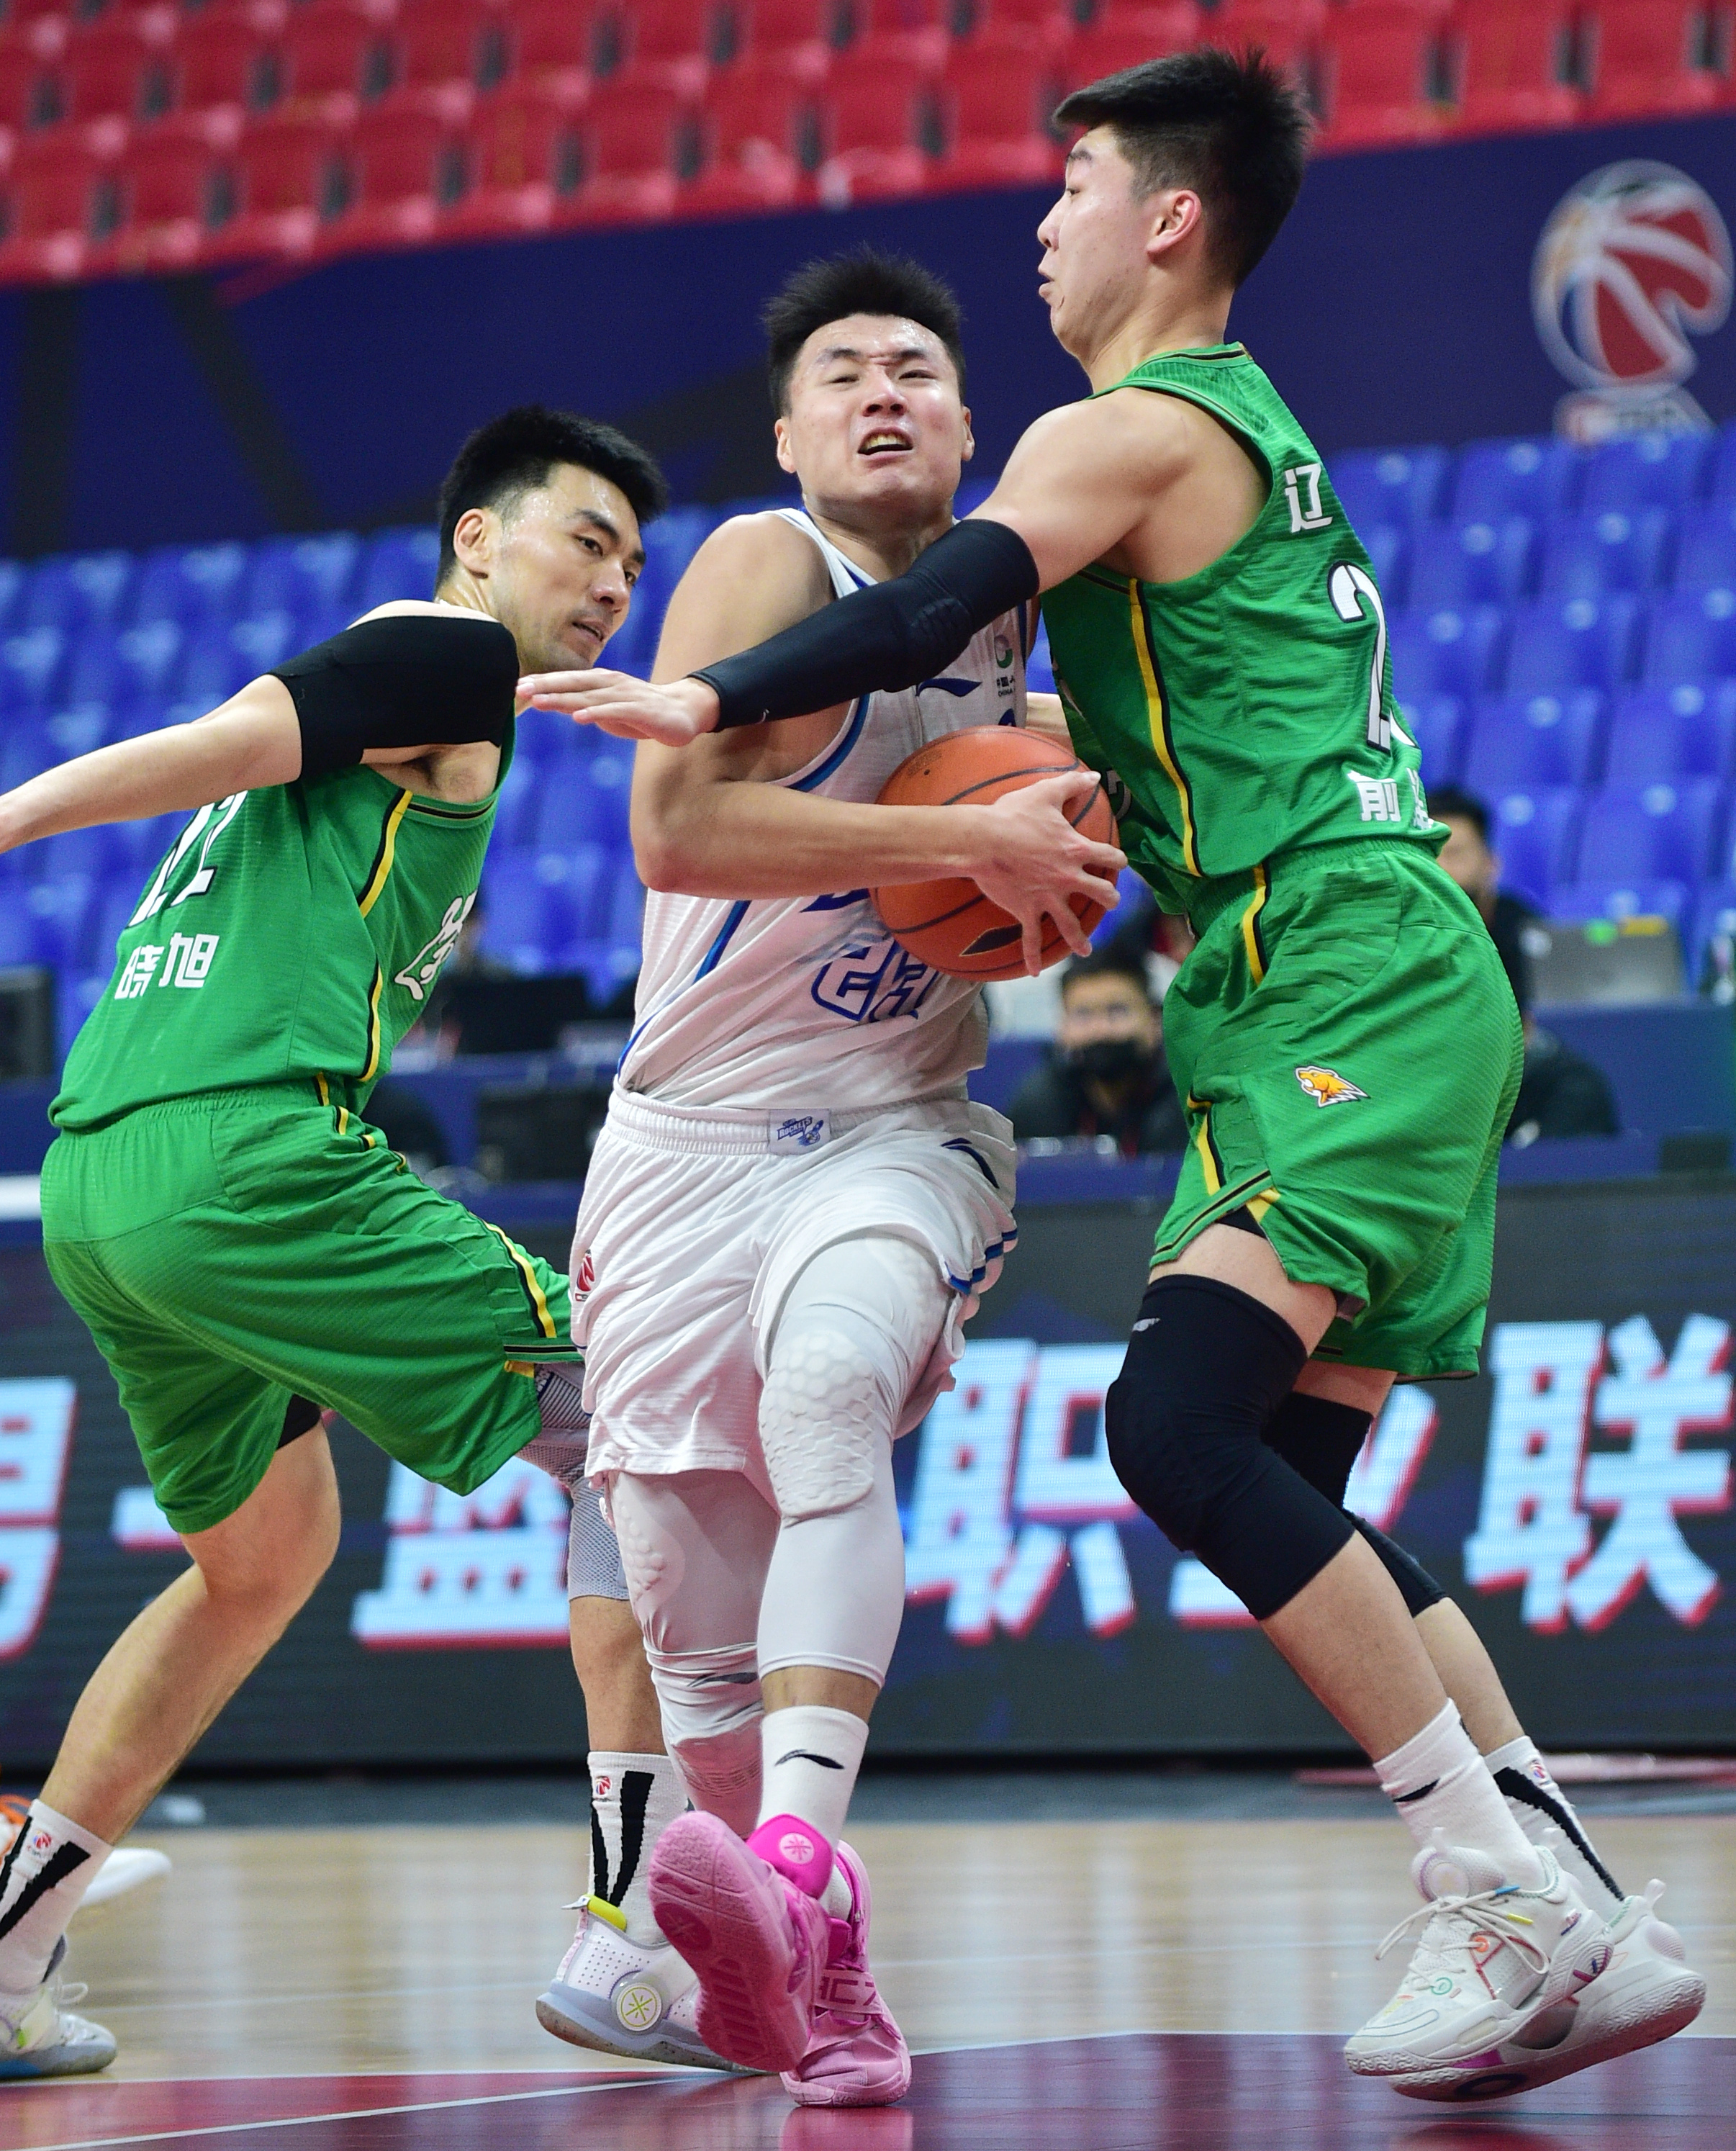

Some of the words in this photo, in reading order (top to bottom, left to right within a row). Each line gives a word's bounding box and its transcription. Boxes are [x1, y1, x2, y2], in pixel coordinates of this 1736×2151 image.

[1284, 463, 1333, 533] 辽
[114, 932, 220, 1000] 晓旭
[777, 1116, 813, 1141] ROCKETS
